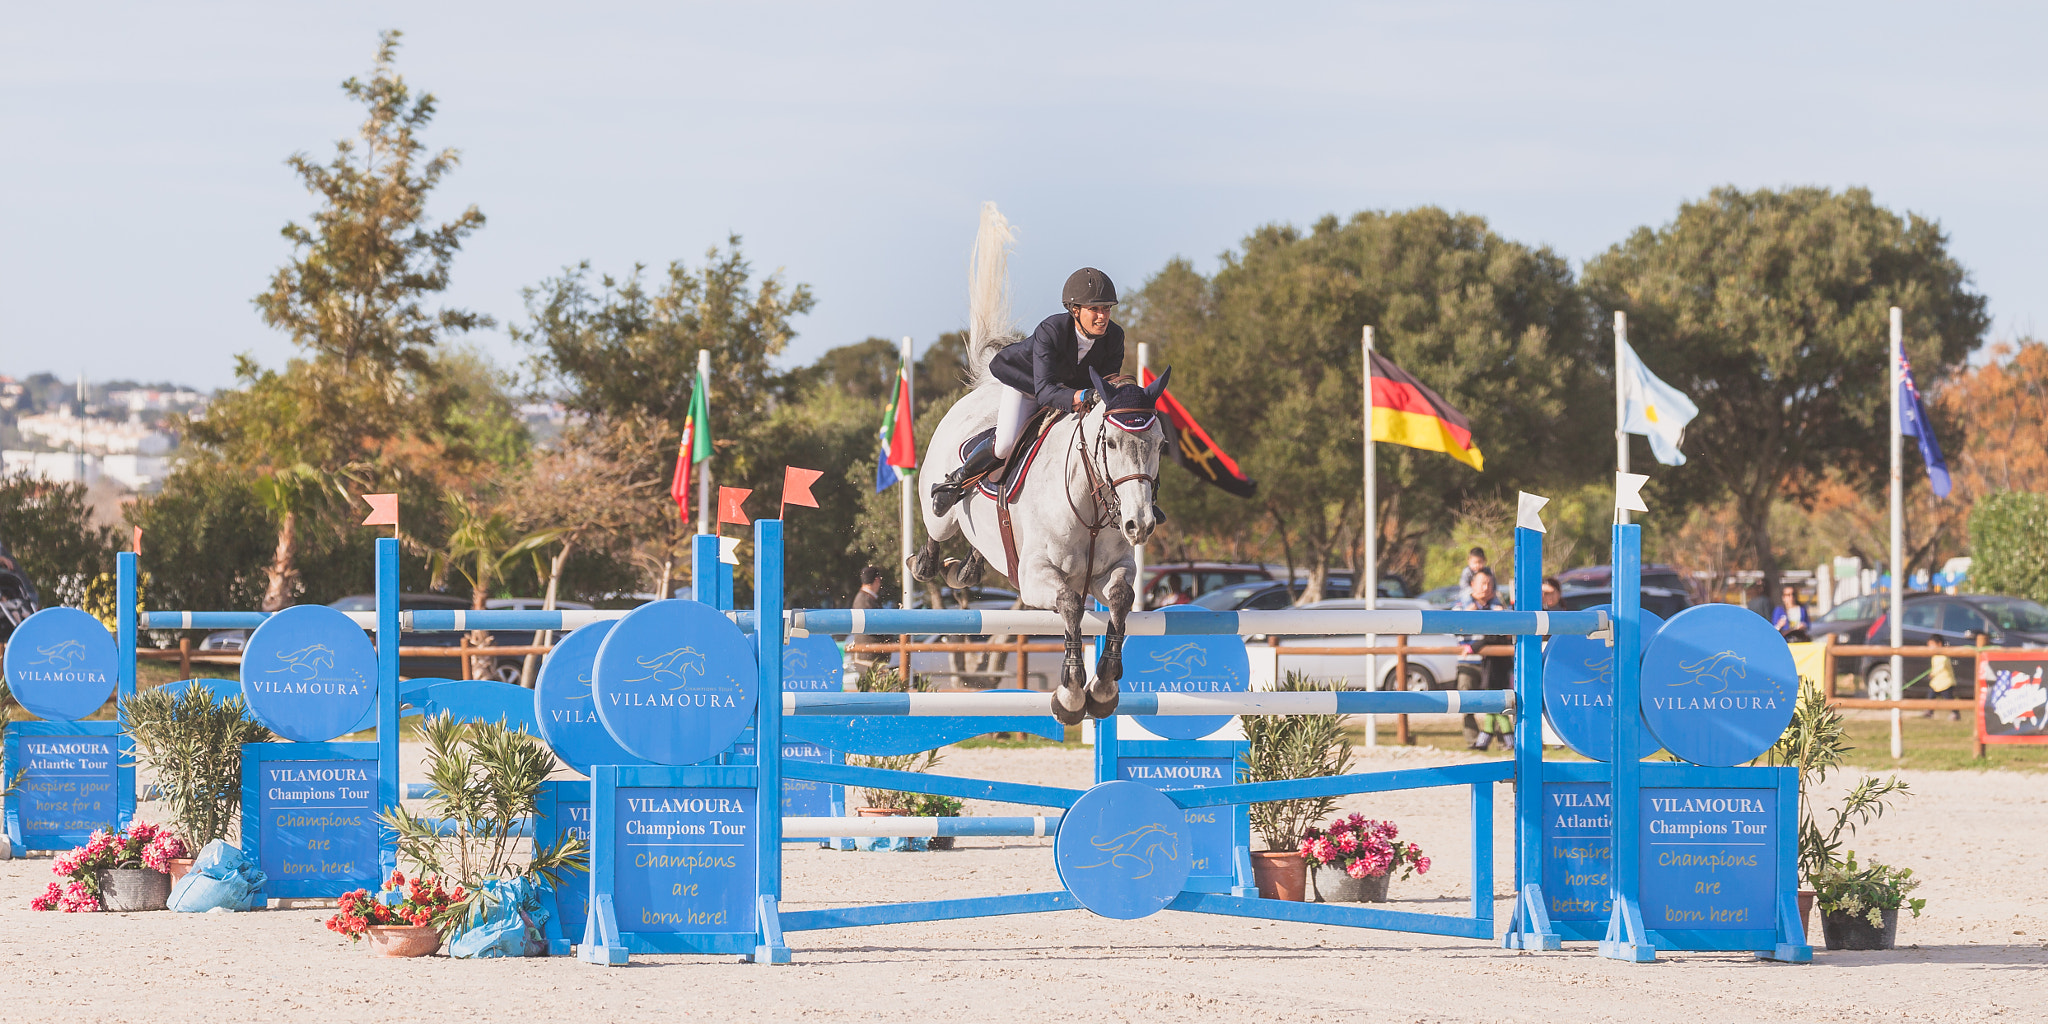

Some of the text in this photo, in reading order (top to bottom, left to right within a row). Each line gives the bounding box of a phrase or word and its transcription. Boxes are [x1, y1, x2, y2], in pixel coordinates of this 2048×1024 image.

[18, 671, 106, 683] VILAMOURA
[253, 681, 359, 695] VILAMOURA
[1128, 681, 1232, 692] VILAMOURA
[610, 693, 736, 708] VILAMOURA
[1654, 697, 1777, 710] VILAMOURA
[27, 744, 109, 754] VILAMOURA
[29, 759, 108, 769] Atlantic Tour
[269, 769, 367, 782] VILAMOURA
[1127, 766, 1222, 779] VILAMOURA
[27, 780, 111, 797] Inspires your
[268, 787, 370, 804] Champions Tour
[36, 798, 102, 814] horse for a
[627, 798, 744, 813] VILAMOURA
[1651, 798, 1766, 813] VILAMOURA
[26, 818, 60, 830] better
[276, 812, 361, 832] Champions
[1649, 820, 1767, 839] Champions Tour
[625, 820, 746, 840] Champions Tour
[308, 839, 330, 850] are
[283, 859, 354, 874] born here!
[635, 850, 736, 875] Champions
[1658, 849, 1758, 873] Champions
[1565, 870, 1608, 886] horse
[672, 882, 699, 897] are
[1694, 881, 1721, 895] are
[1552, 896, 1598, 912] better
[642, 906, 727, 925] born here!
[1665, 904, 1748, 922] born here!
